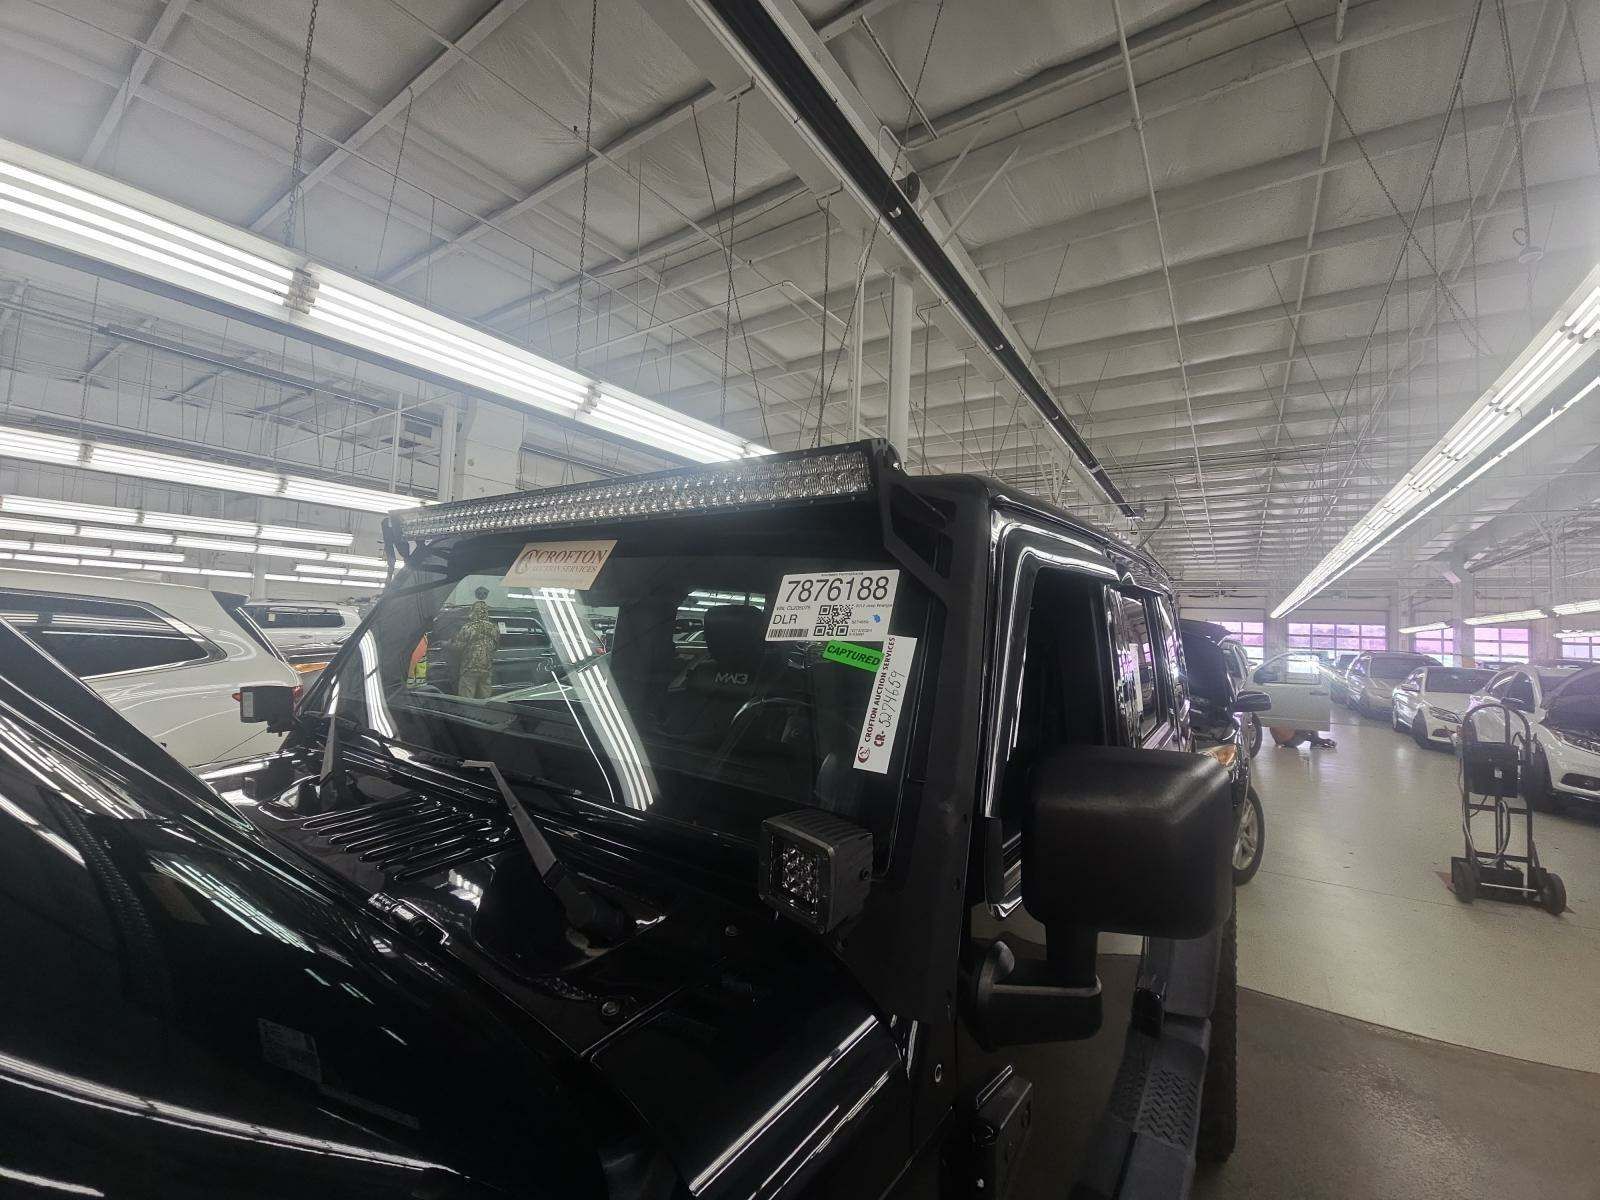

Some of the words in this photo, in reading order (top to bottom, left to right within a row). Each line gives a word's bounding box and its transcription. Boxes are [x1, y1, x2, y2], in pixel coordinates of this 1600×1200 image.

[537, 550, 608, 564] CROFTON
[786, 576, 889, 602] 7876188
[773, 614, 798, 624] DLR
[827, 645, 880, 666] CAPTURED
[864, 707, 878, 743] CROFTON
[873, 672, 887, 706] AUCTION
[884, 636, 896, 671] SERVICES
[873, 730, 886, 748] CR-
